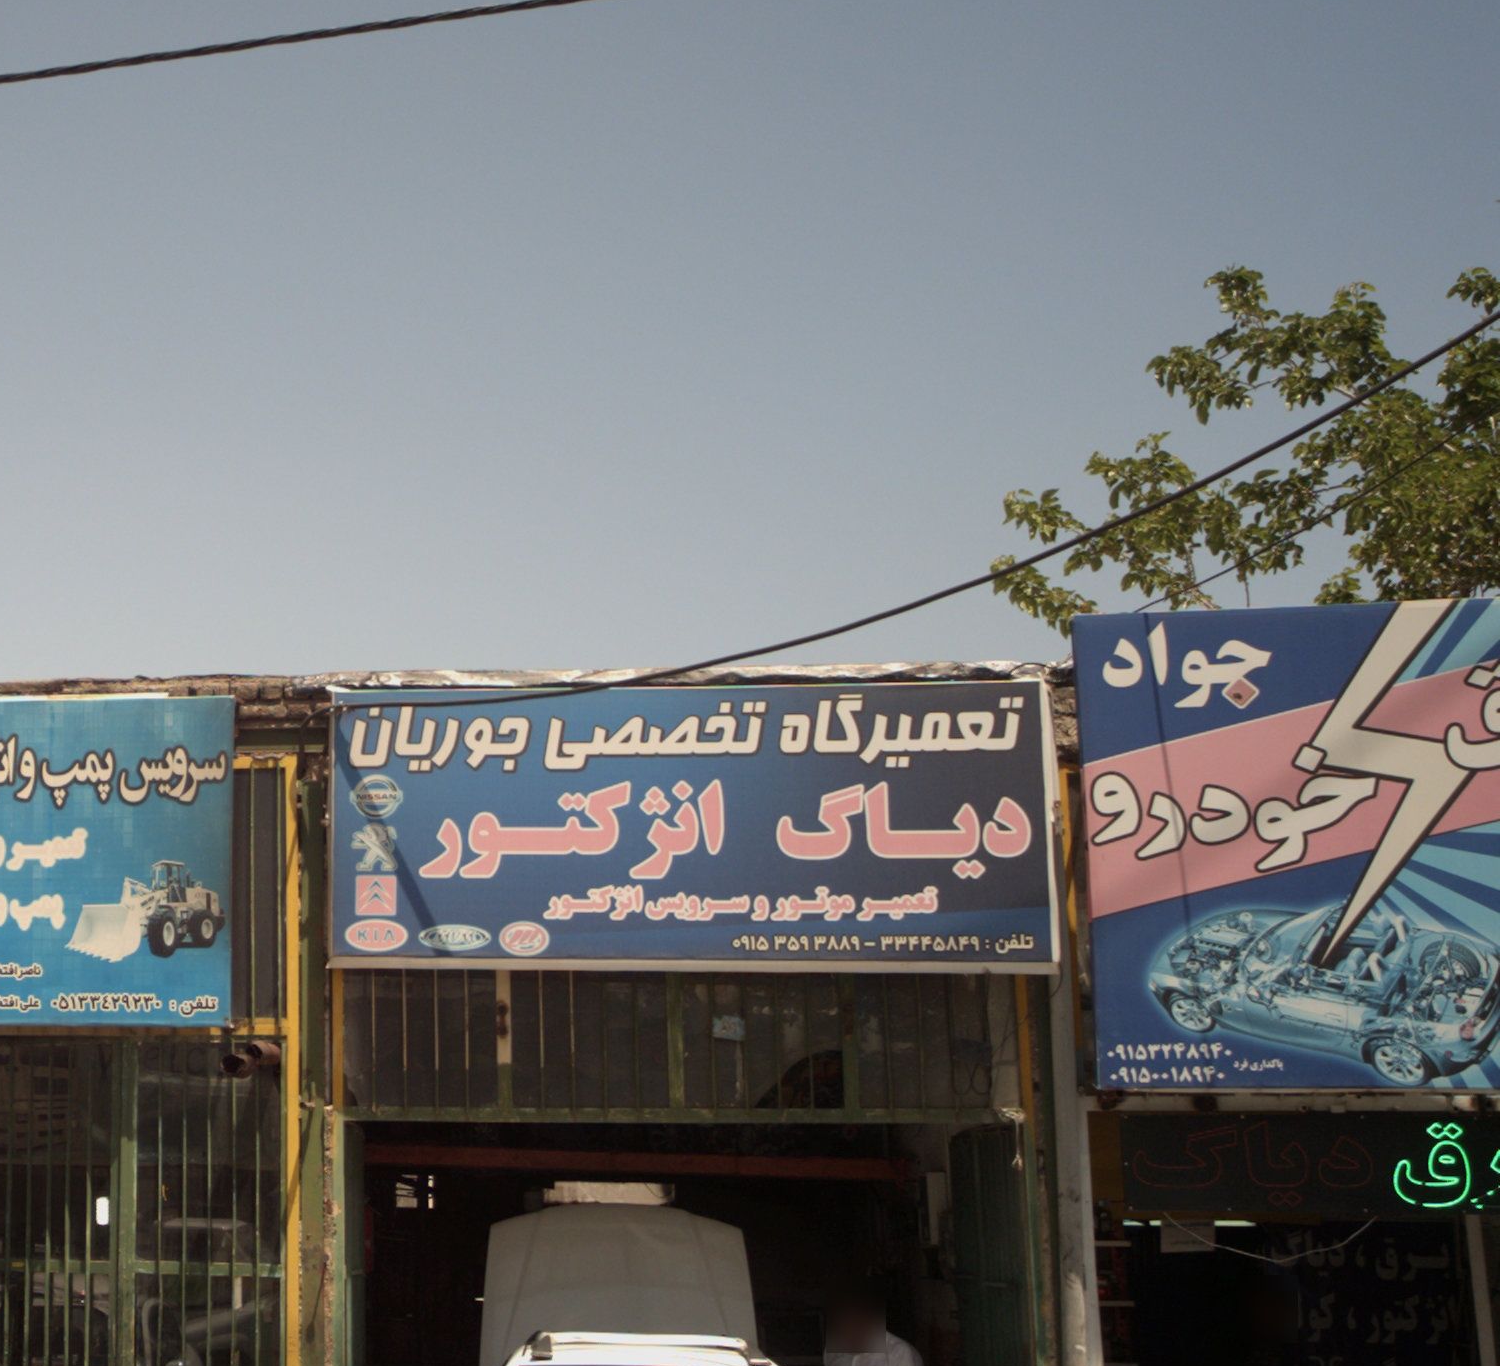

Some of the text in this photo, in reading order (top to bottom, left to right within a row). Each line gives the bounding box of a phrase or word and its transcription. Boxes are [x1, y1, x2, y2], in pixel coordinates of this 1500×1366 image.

[1102, 621, 1272, 709] جواد
[348, 694, 1023, 773] تعمیرگاه تخصصی جوریان
[16, 759, 36, 801] و
[41, 746, 116, 808] پمپ
[119, 746, 228, 804] سرویس
[418, 779, 1032, 879] دیاگ انژکتور
[1091, 743, 1379, 874] خودرو
[542, 884, 939, 922] تعمیر موتور و سرویس انژکتور
[357, 929, 396, 942] KIA
